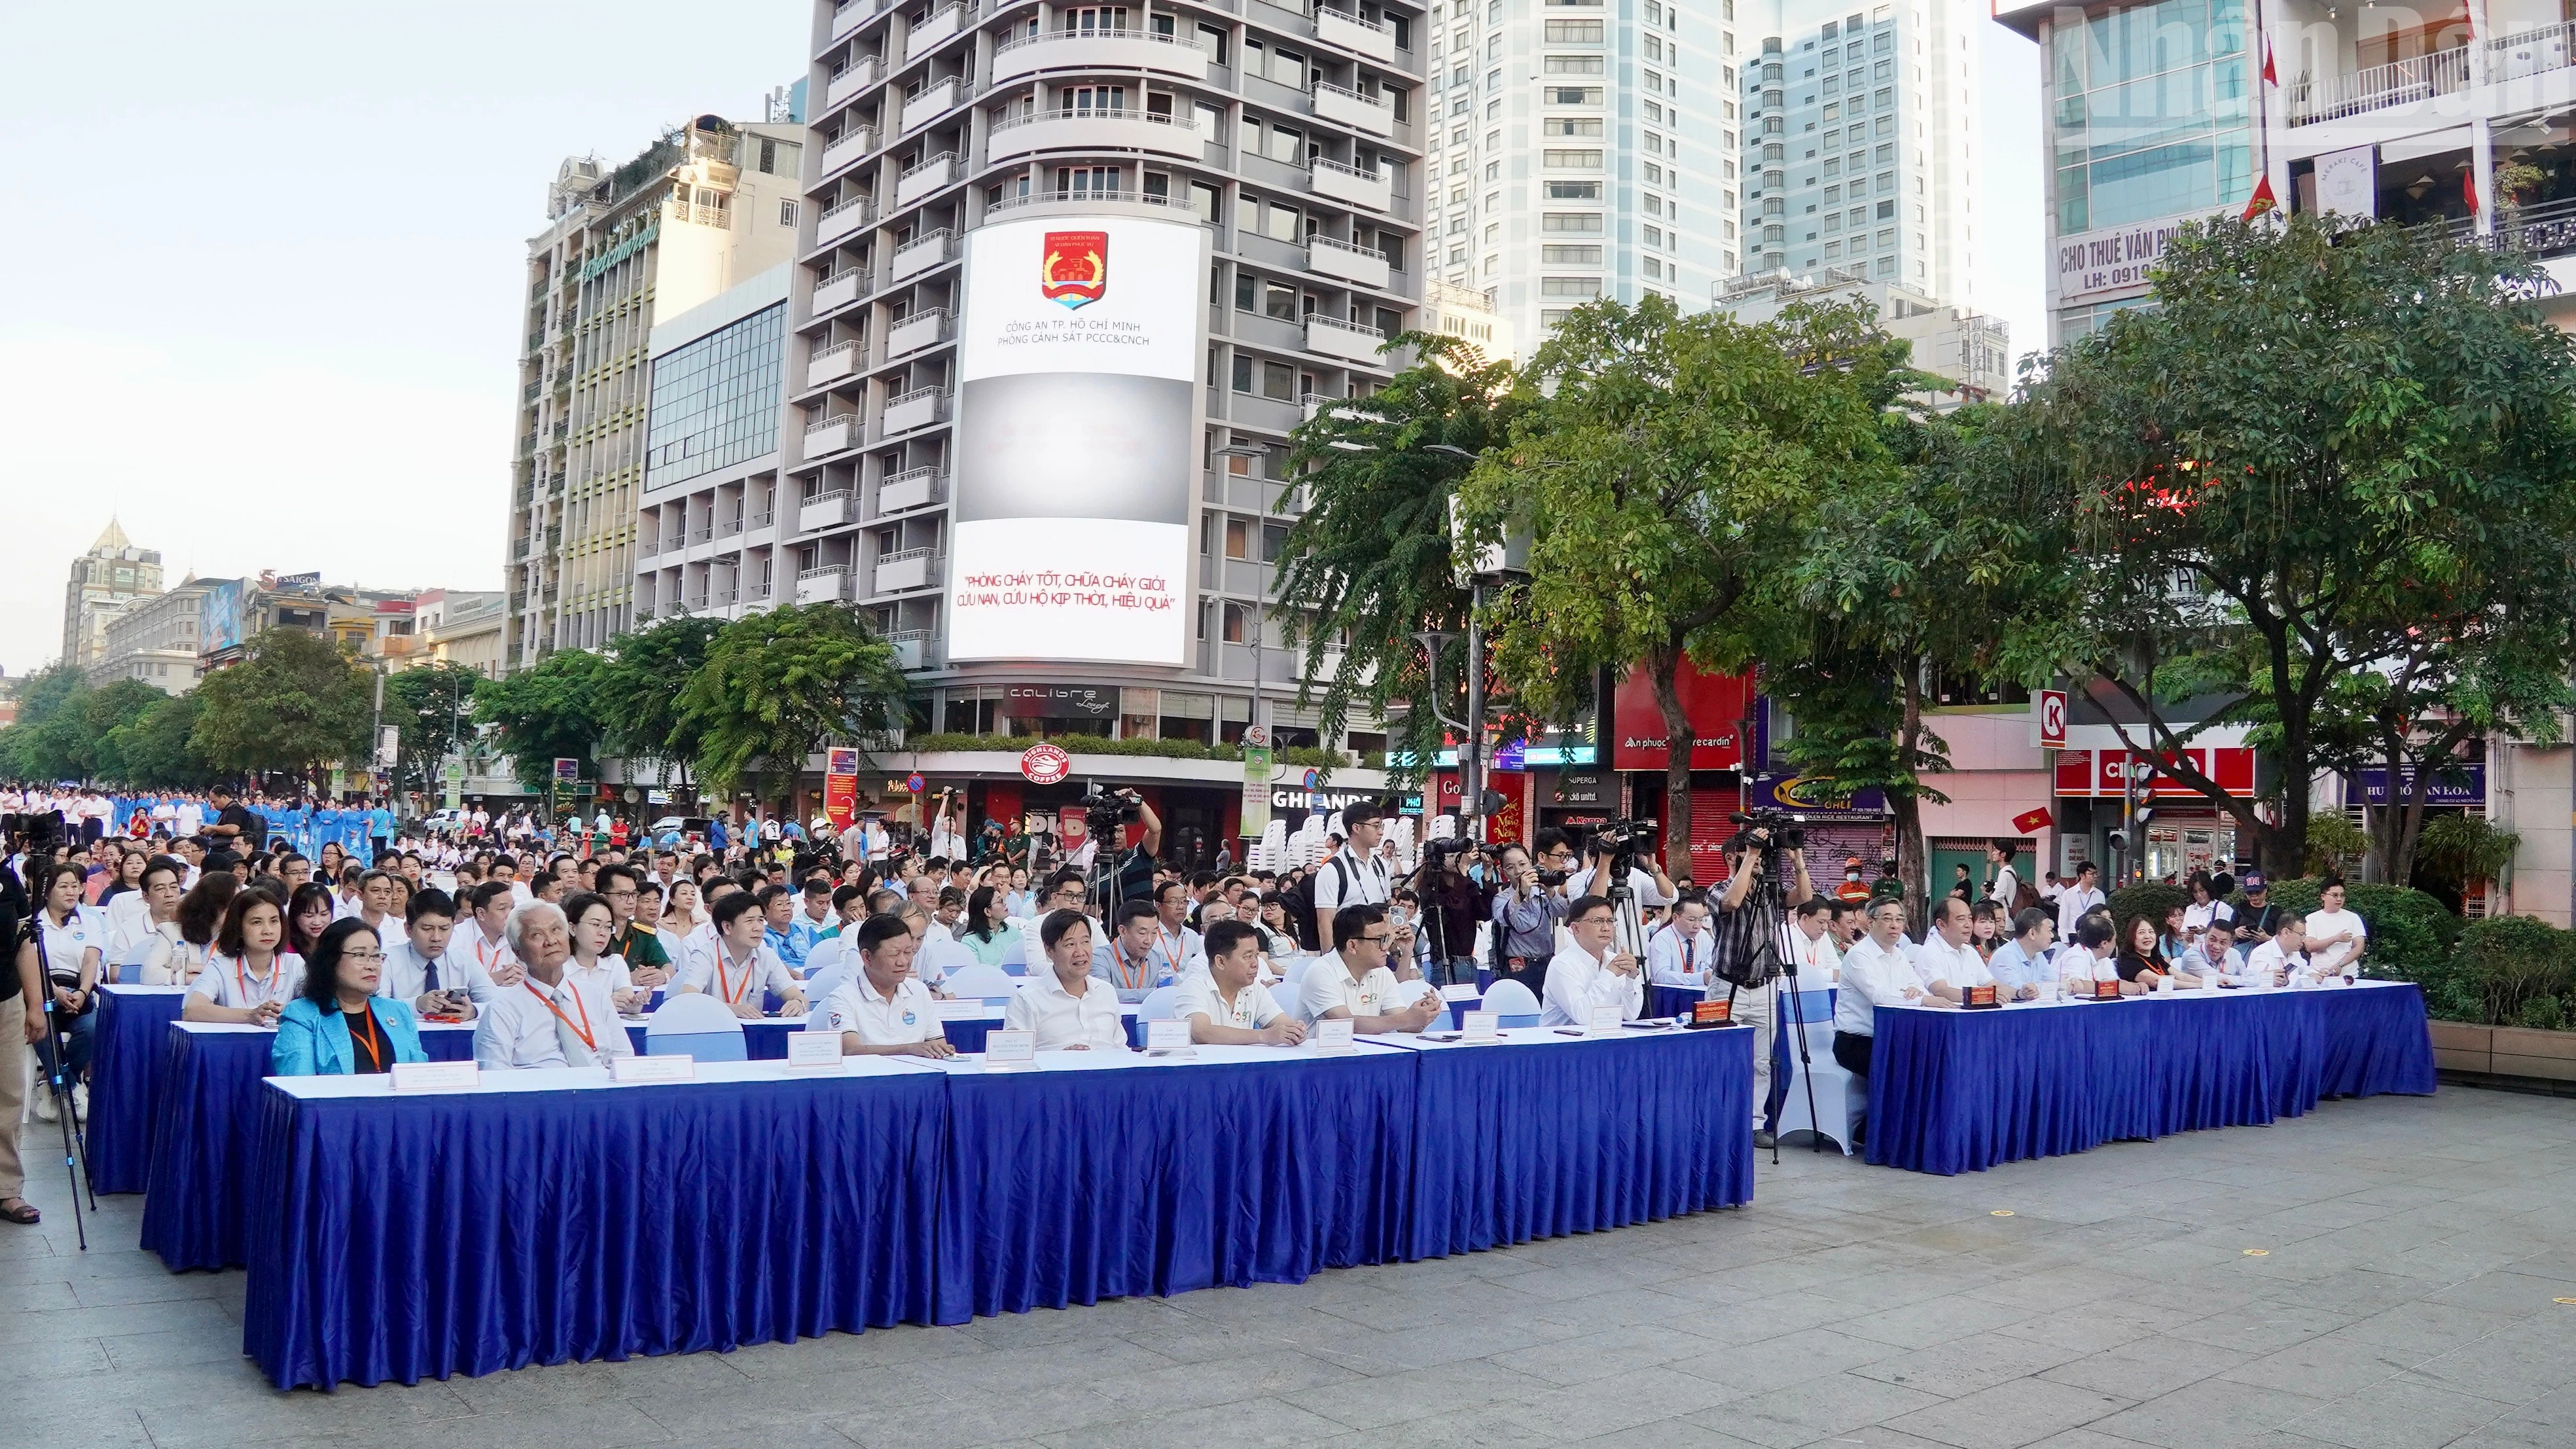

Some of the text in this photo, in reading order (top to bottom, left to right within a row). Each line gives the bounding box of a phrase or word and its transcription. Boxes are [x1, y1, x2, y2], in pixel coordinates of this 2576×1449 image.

[2321, 157, 2347, 181] MERAKI
[2061, 244, 2085, 274] CHO
[2089, 232, 2122, 268] THUÊ
[2126, 228, 2153, 260] VĂN
[2084, 272, 2107, 290] LH:
[1006, 317, 1140, 332] CÔNG AN TP. HỒ CHÍ MINH
[998, 331, 1149, 346] PHÒNG CẢNH SÁT PCCC&CNCH
[1971, 319, 1981, 384] HOTEL
[1004, 570, 1033, 586] CHÁY
[1065, 571, 1100, 587] CHỮA
[1103, 573, 1136, 588] CHÁY
[1139, 575, 1166, 591] GIỎI
[957, 590, 976, 606] CỨU
[978, 592, 1001, 608] NẠN,
[1003, 588, 1027, 604] CỨU
[1030, 588, 1048, 607] HỘ
[1051, 592, 1071, 607] KỊP
[1073, 590, 1108, 608] THỜI,
[1113, 592, 1141, 609] HIỆU
[1703, 736, 1730, 747] cardin
[1023, 746, 1067, 763] HIGHLANDS
[1028, 773, 1062, 782] COFFEE
[2365, 787, 2384, 795] HU
[2246, 877, 2260, 886] 114
